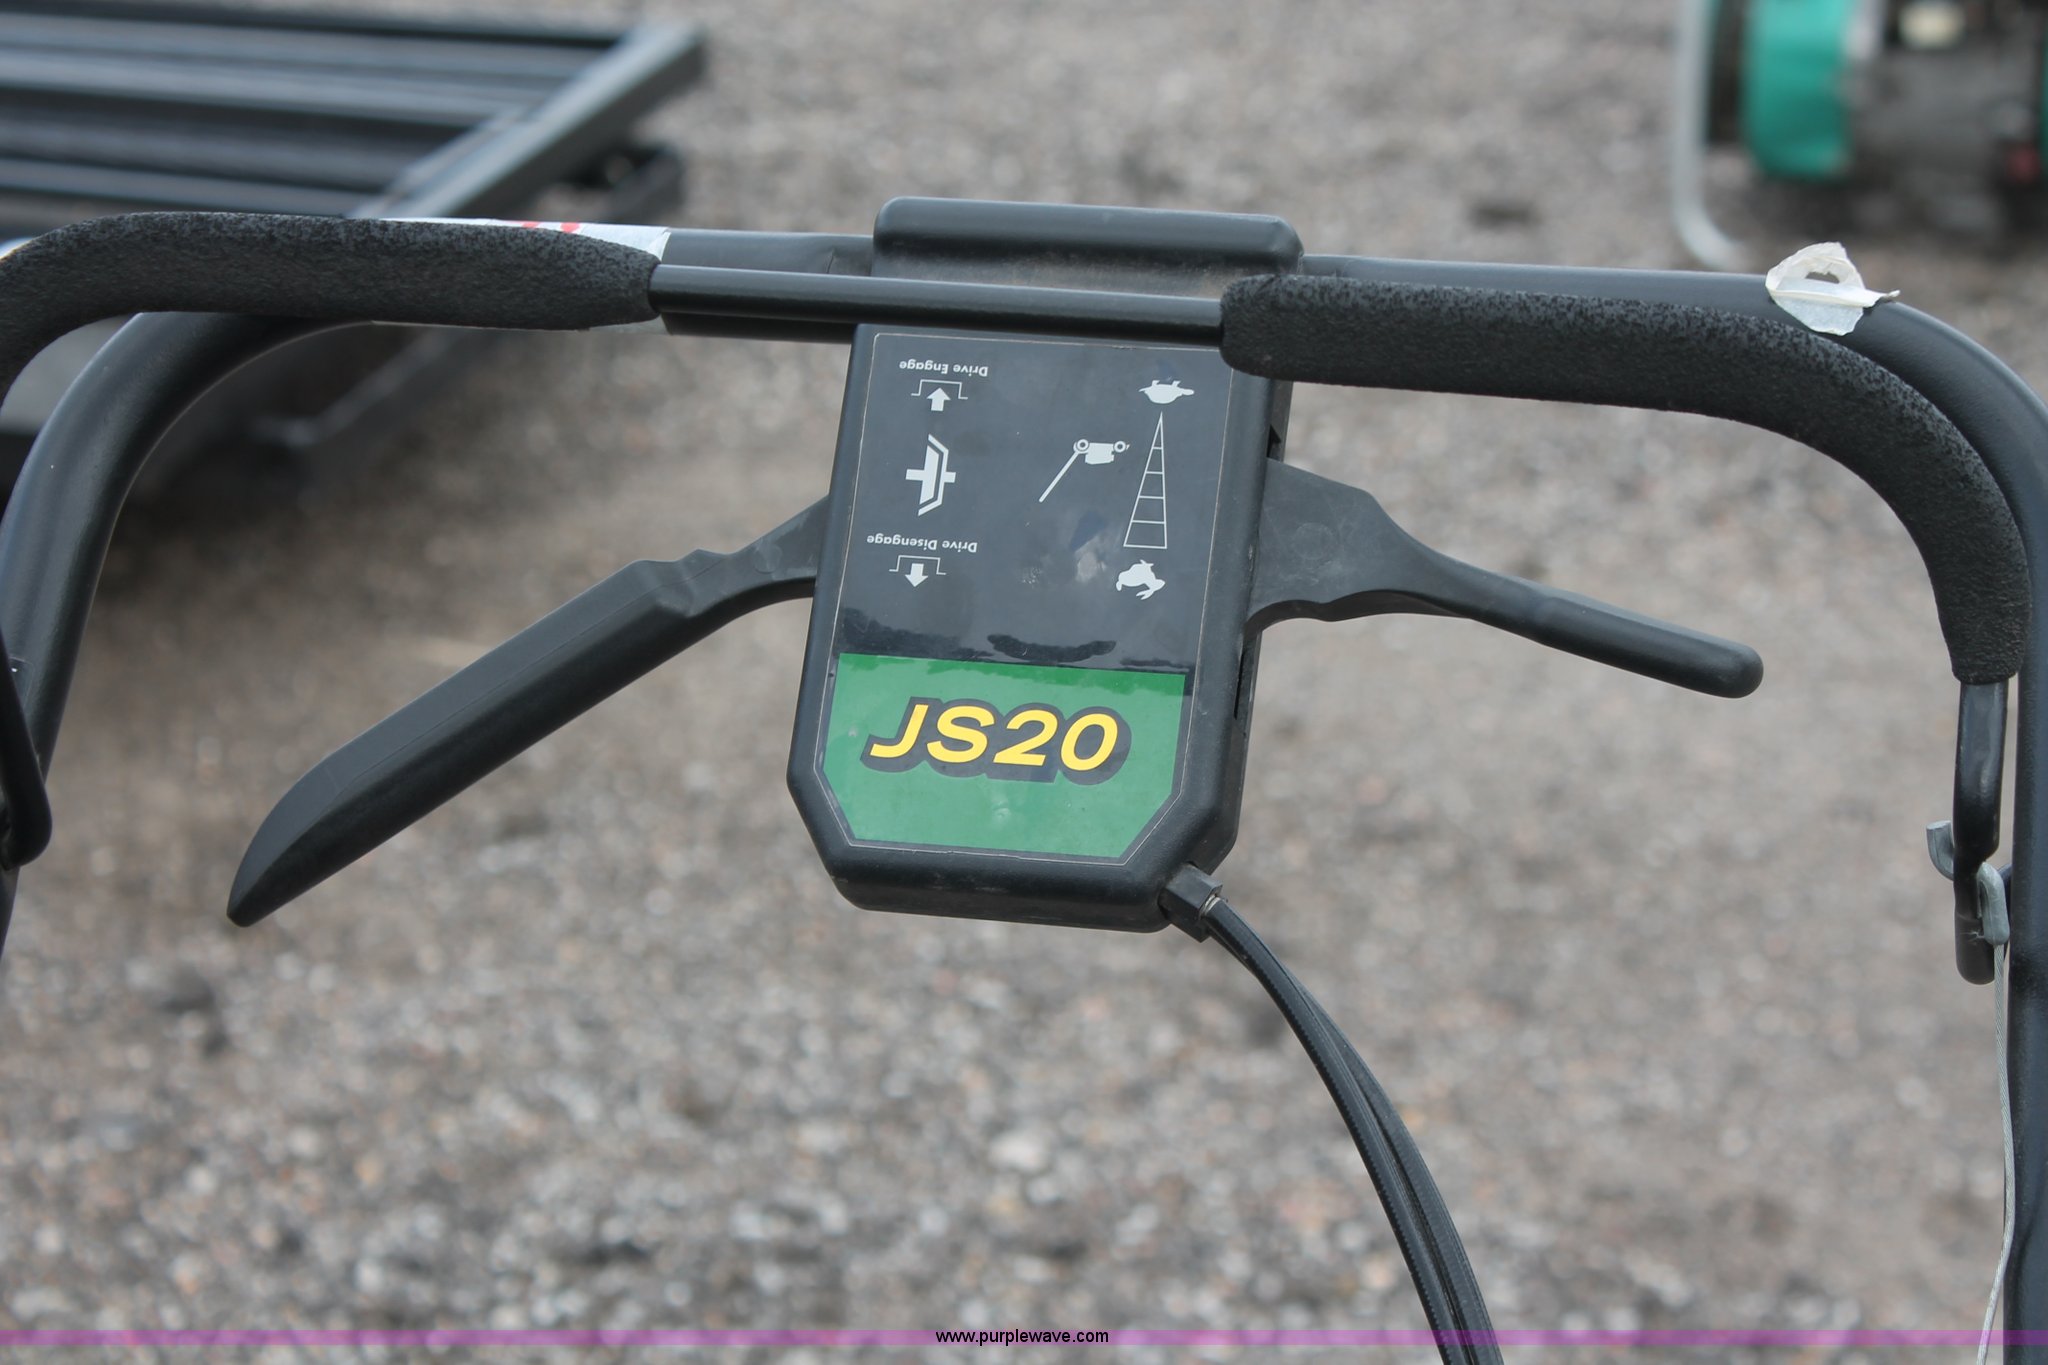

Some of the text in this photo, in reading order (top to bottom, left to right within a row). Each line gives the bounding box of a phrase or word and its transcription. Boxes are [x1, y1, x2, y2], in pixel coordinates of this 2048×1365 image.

[899, 359, 988, 377] Drive Engage
[866, 533, 978, 553] Drive Disengage
[869, 703, 1119, 772] JS20
